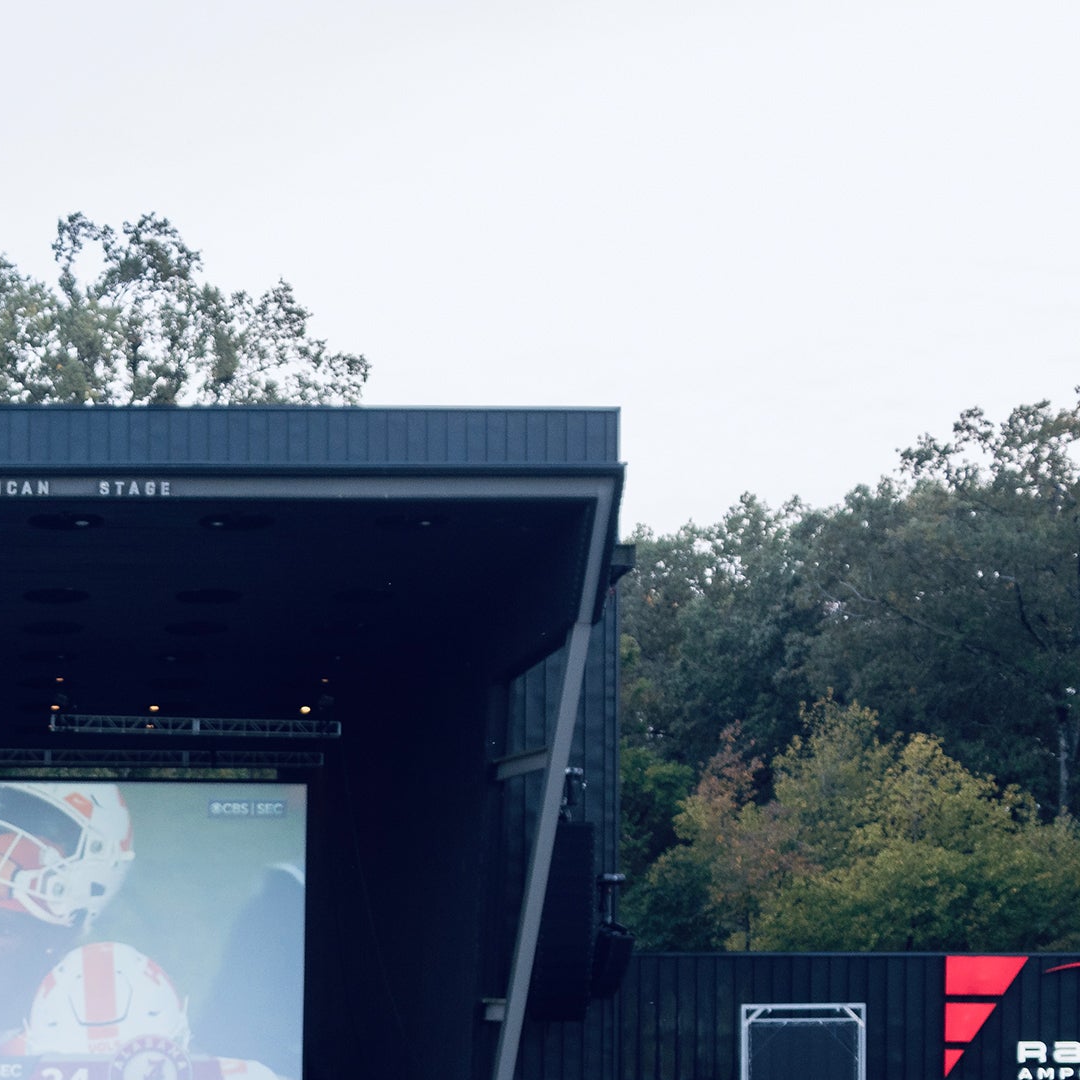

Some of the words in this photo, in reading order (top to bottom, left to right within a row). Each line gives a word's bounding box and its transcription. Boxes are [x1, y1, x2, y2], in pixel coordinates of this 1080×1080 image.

[98, 480, 172, 496] STAGE
[223, 802, 249, 814] CBS
[256, 802, 283, 815] SEC
[1017, 1067, 1080, 1080] AMP
